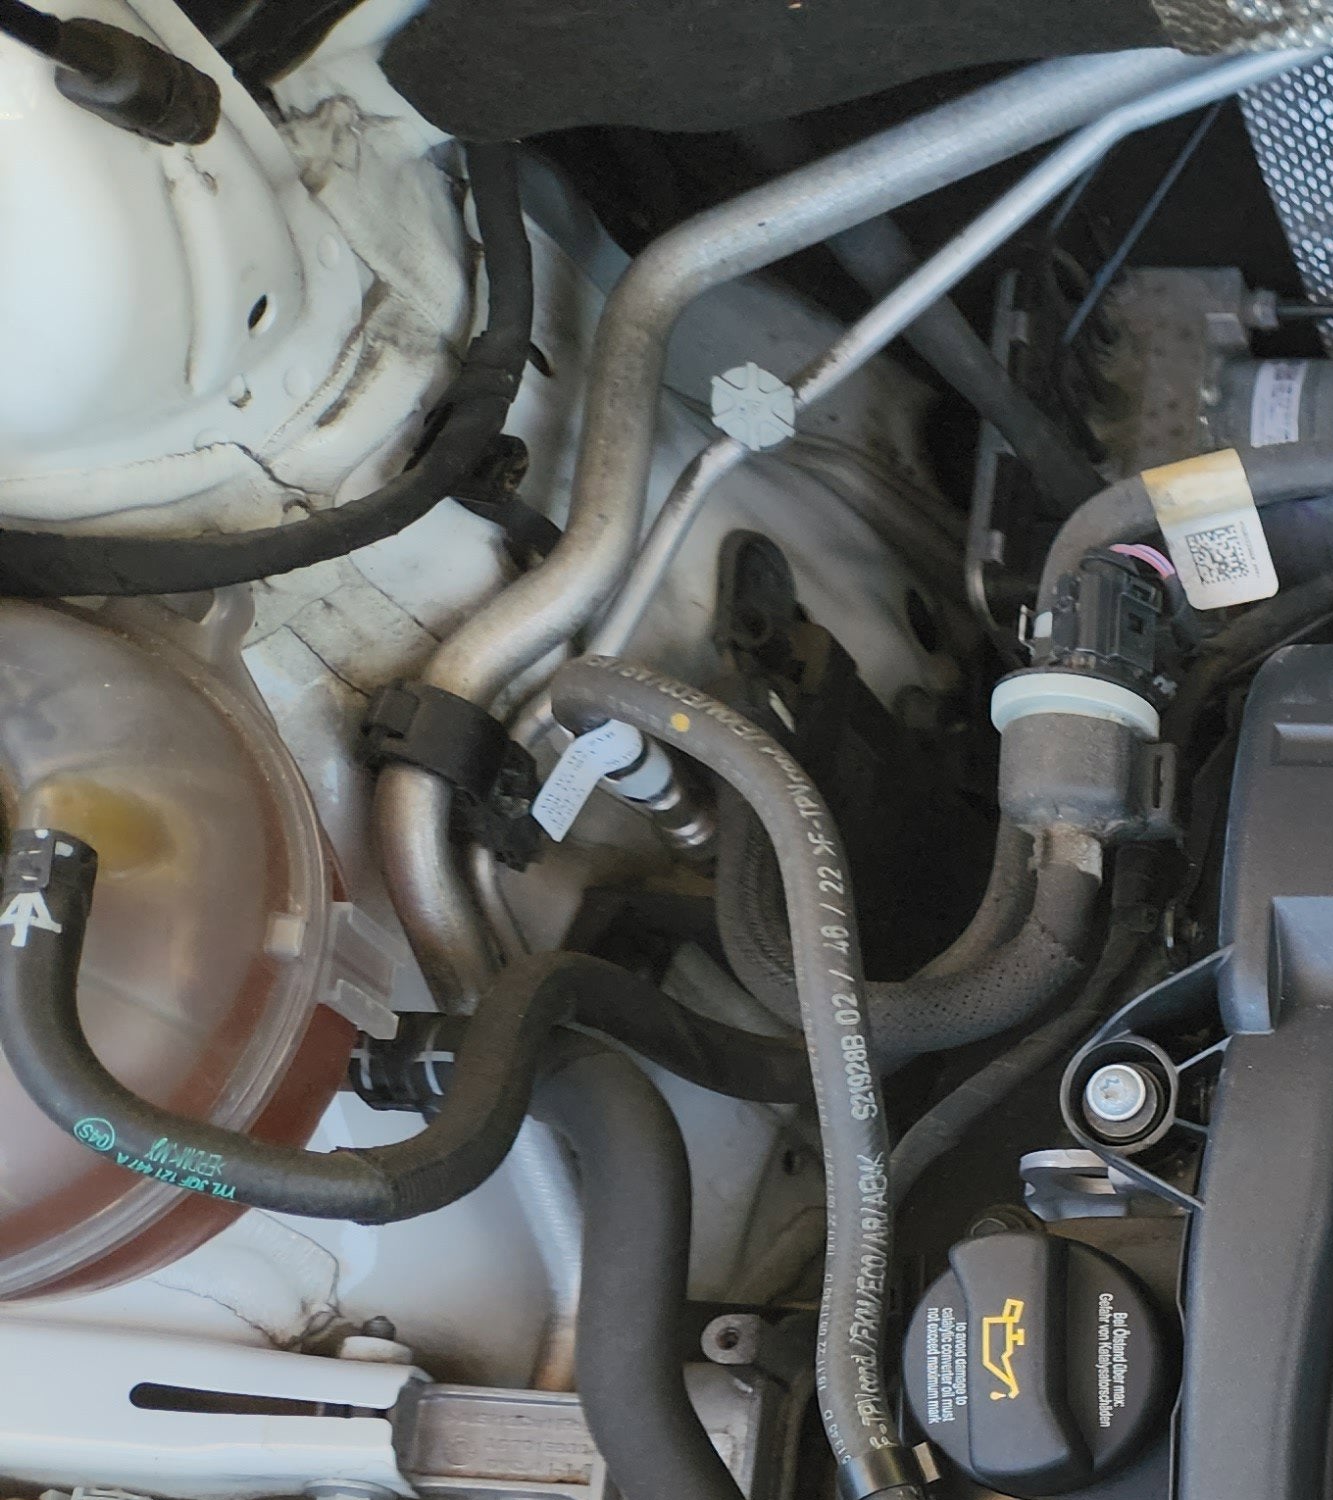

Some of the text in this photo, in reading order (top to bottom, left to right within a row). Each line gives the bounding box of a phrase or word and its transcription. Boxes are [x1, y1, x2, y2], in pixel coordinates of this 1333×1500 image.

[817, 866, 845, 894] 22
[831, 993, 861, 1026] 02
[840, 1034, 878, 1121] S21928B
[116, 1152, 130, 1164] A
[155, 1167, 178, 1183] 121
[955, 1333, 967, 1357] avoid
[1095, 1293, 1113, 1427] Gefahr von Katalysatorschäden
[1112, 1328, 1131, 1362] Ölstand
[928, 1307, 941, 1424] not exceed maximum mark
[940, 1308, 955, 1422] catalytic converter oil must
[953, 1358, 967, 1394] damage
[1112, 1363, 1130, 1385] über
[955, 1395, 968, 1406] to
